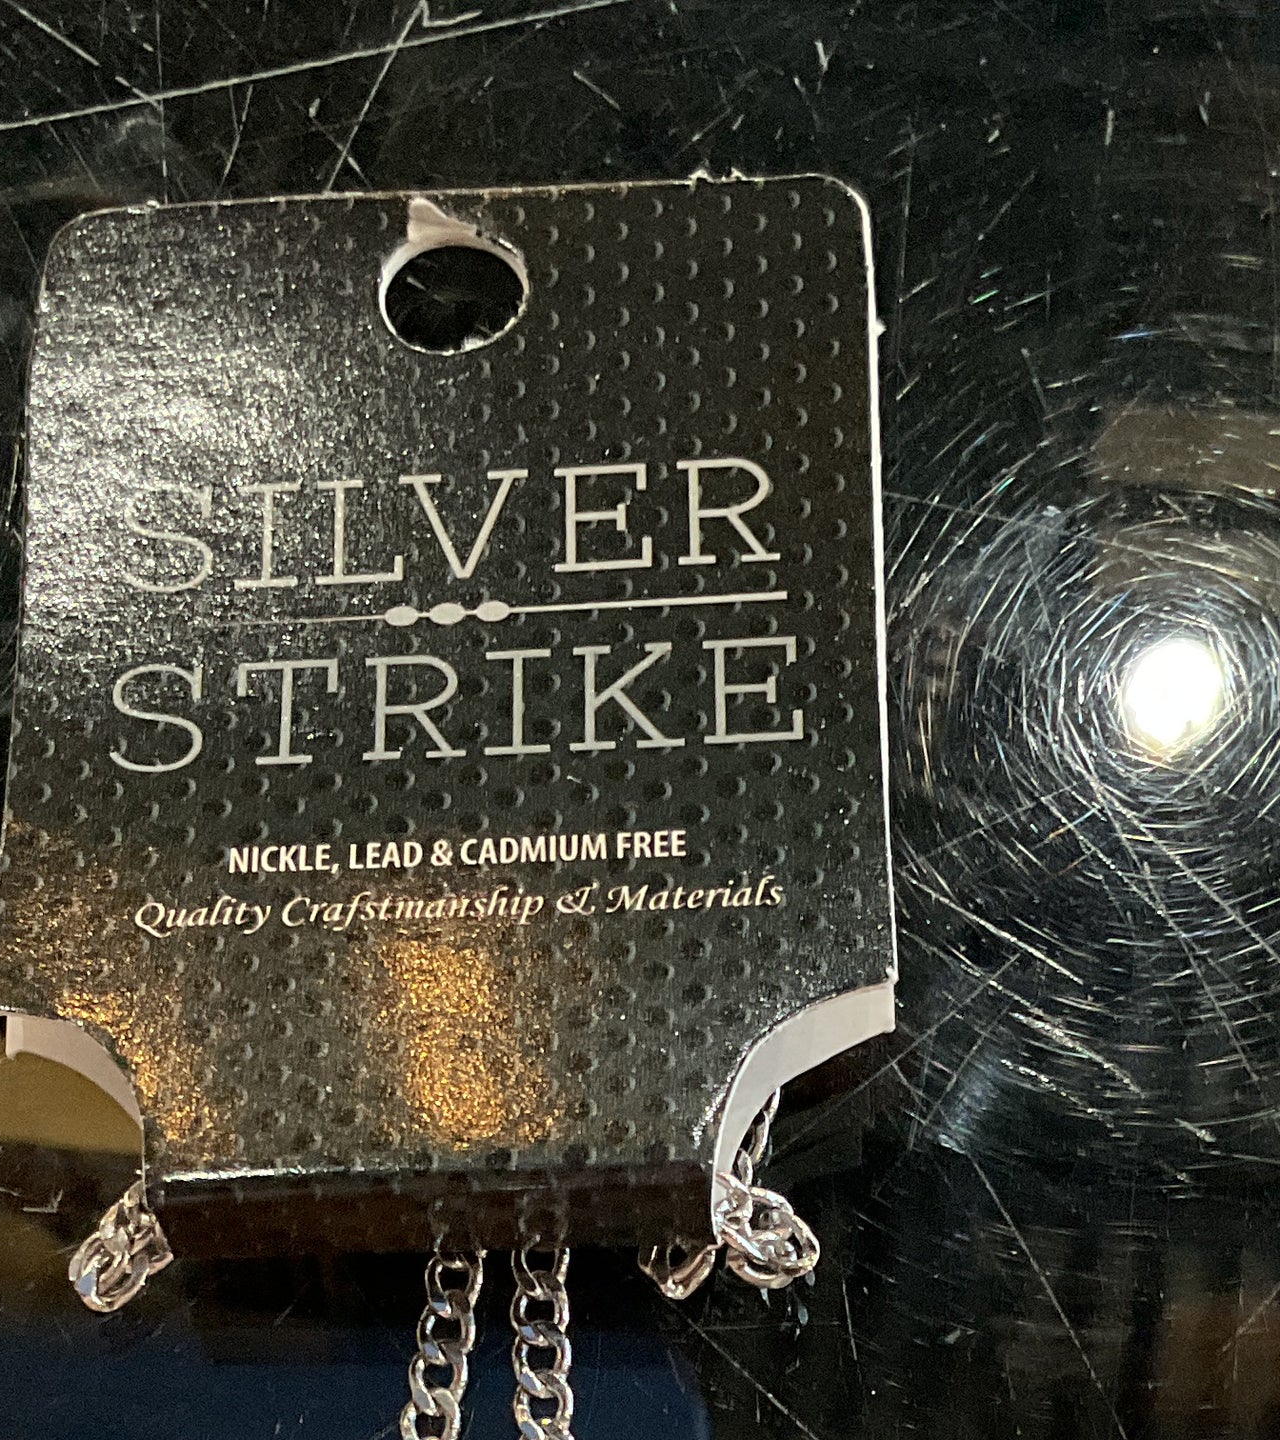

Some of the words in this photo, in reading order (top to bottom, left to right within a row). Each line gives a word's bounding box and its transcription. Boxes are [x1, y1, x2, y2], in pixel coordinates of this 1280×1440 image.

[119, 458, 782, 592] SILVER
[109, 636, 806, 772] STRIKE
[229, 844, 340, 874] NICKLE,
[348, 841, 422, 870] LEAD
[430, 839, 452, 867] &
[460, 832, 607, 867] CADMIUM
[615, 830, 687, 861] FREE
[133, 896, 271, 938] Quality
[605, 875, 783, 912] Materials
